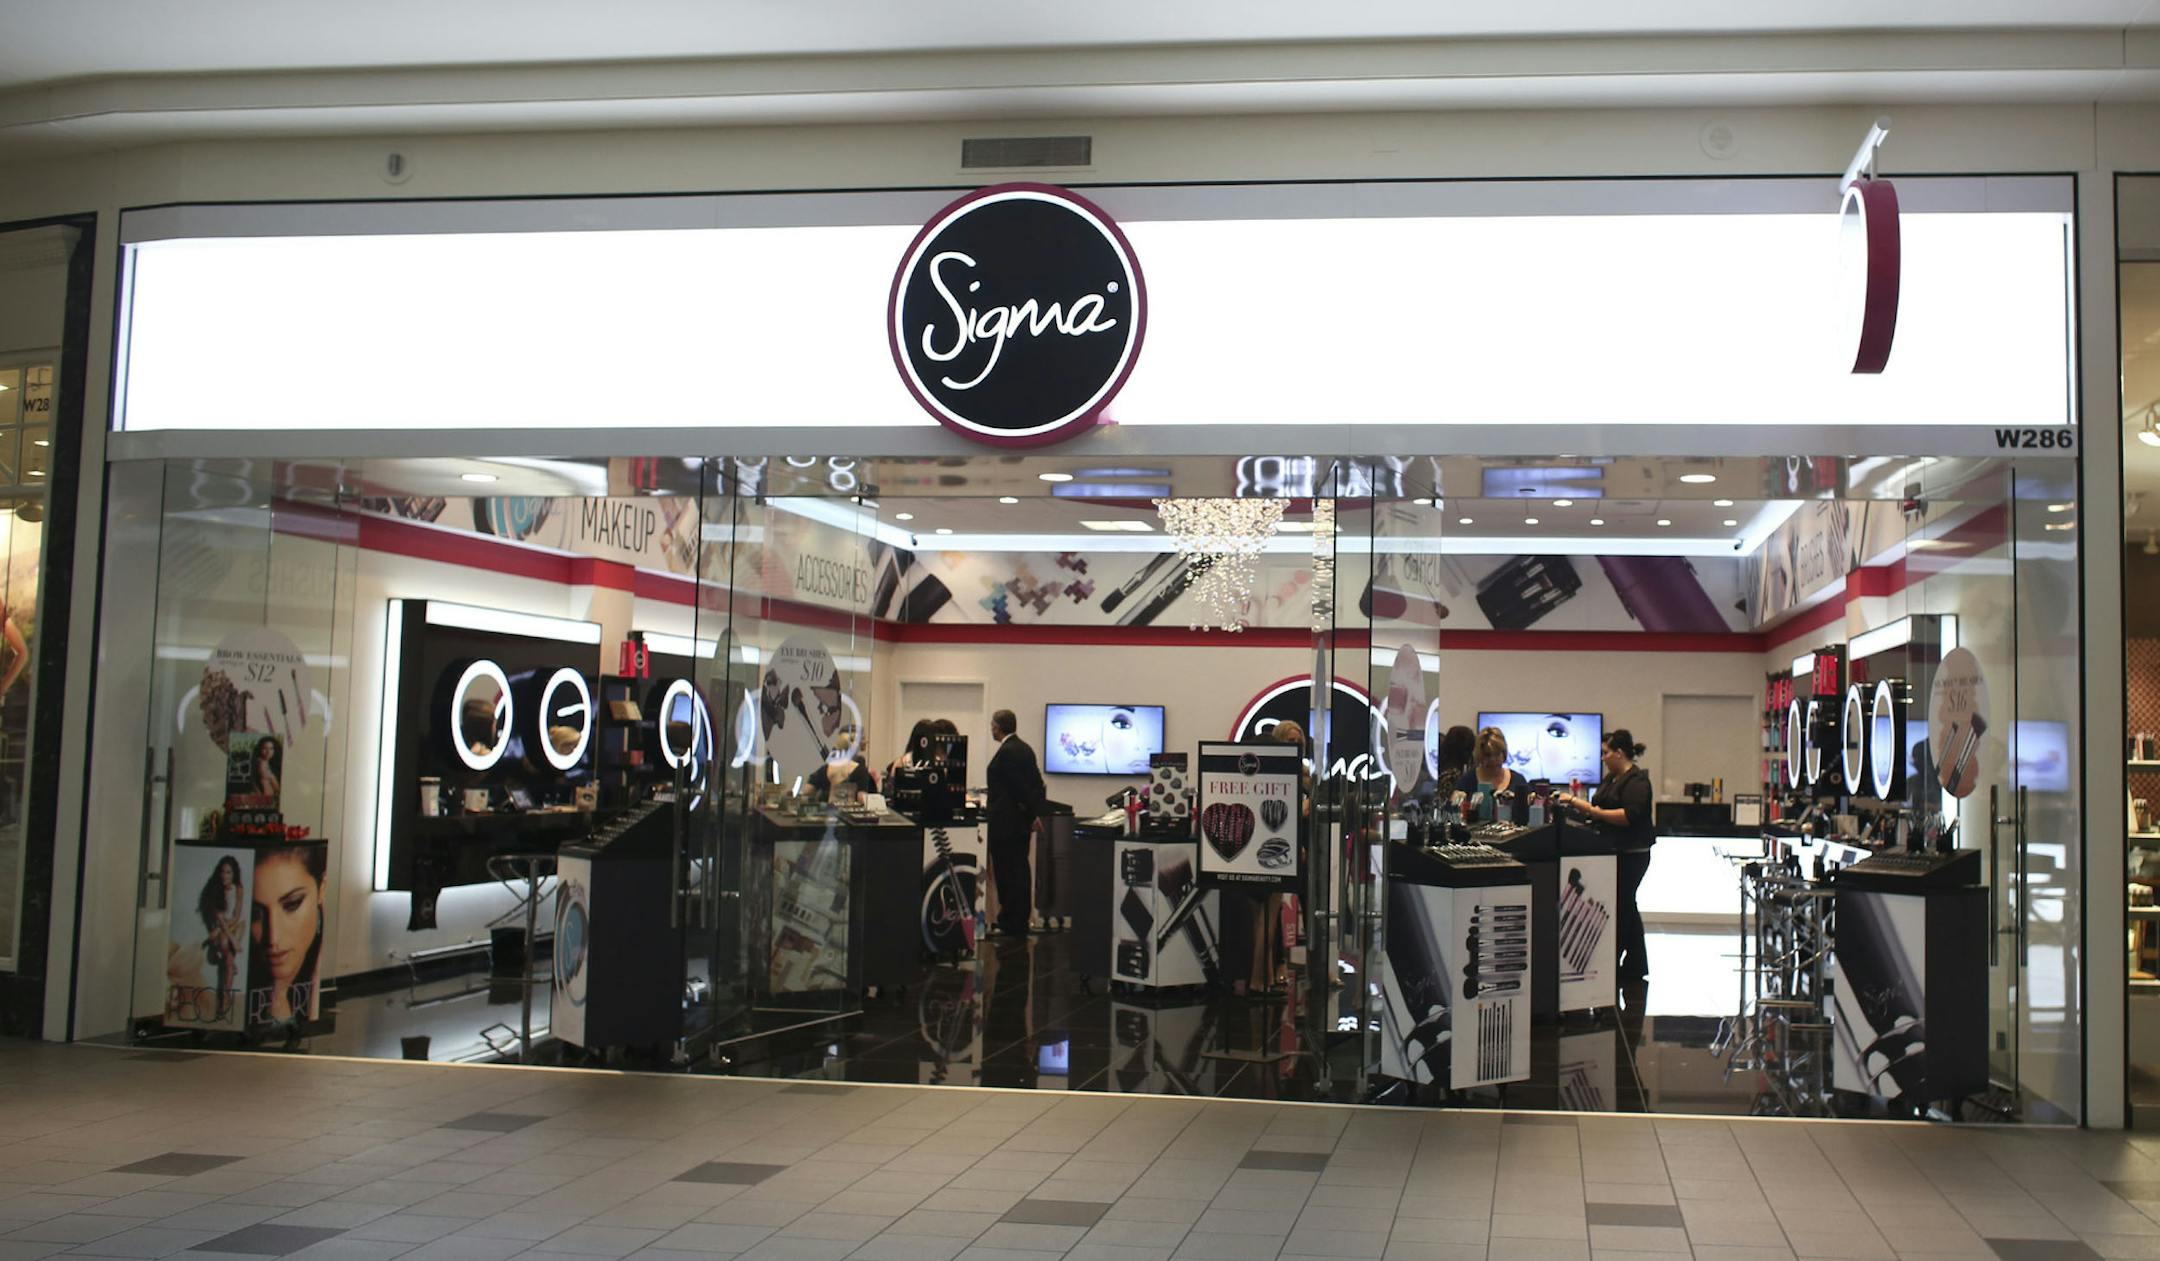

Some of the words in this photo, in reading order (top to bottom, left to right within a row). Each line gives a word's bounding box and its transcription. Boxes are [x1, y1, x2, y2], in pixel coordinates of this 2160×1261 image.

[1995, 429, 2073, 449] W286
[581, 497, 656, 554] MAKEUP
[795, 553, 868, 604] ACCESSORIES
[1210, 781, 1250, 795] FREE
[1254, 782, 1291, 796] GIFT
